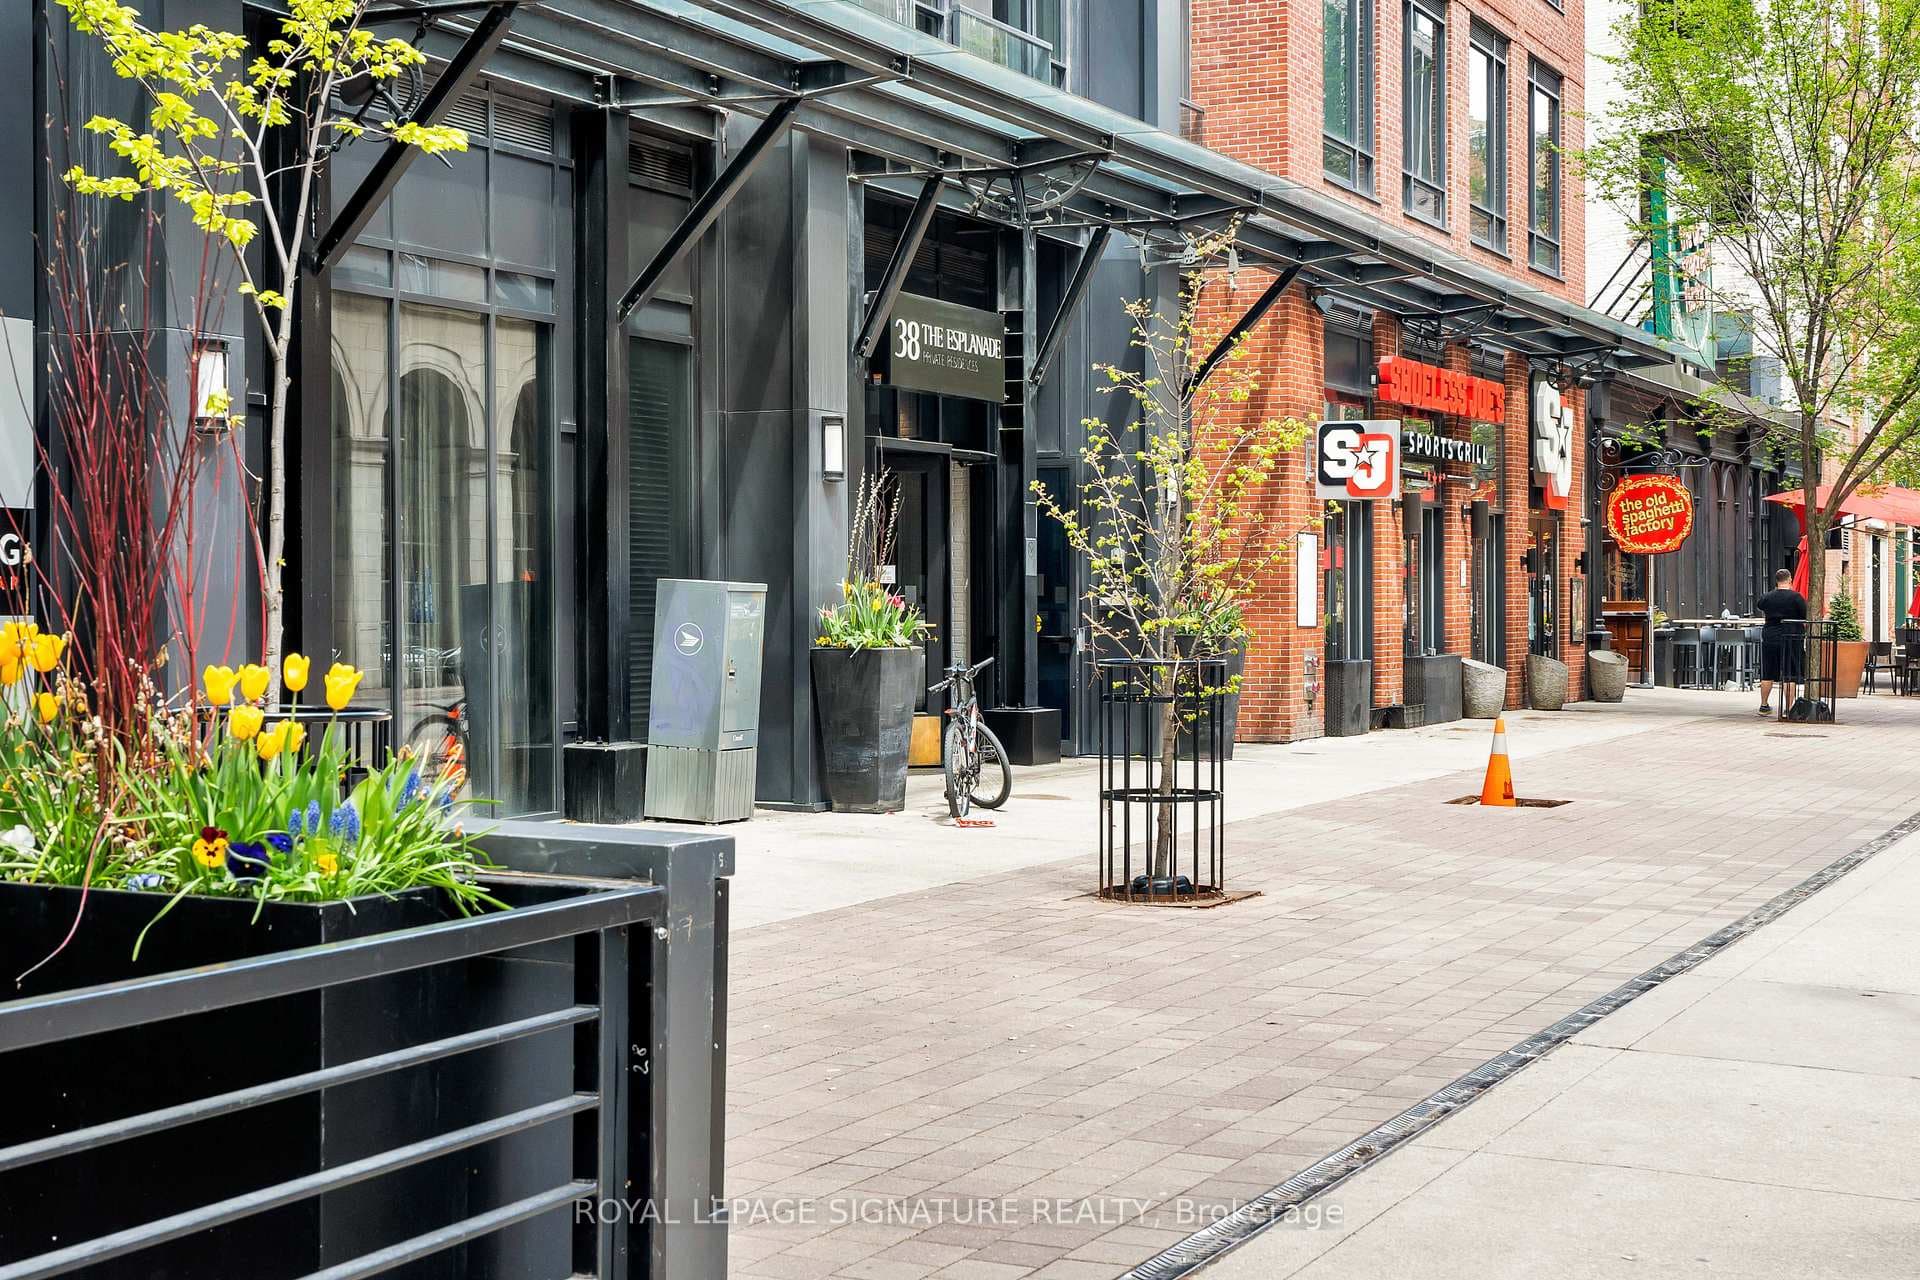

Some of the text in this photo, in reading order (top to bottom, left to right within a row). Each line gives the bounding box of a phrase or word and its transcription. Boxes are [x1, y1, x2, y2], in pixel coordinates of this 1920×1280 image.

[894, 318, 1002, 361] 38 THE ESPLANADE
[922, 351, 945, 367] PRIVATE
[1387, 356, 1468, 416] SHOELESS
[1408, 431, 1488, 465] SPORTS GRILL
[1619, 491, 1668, 513] the old
[1622, 499, 1686, 526] spaghetti
[1623, 517, 1675, 537] factory
